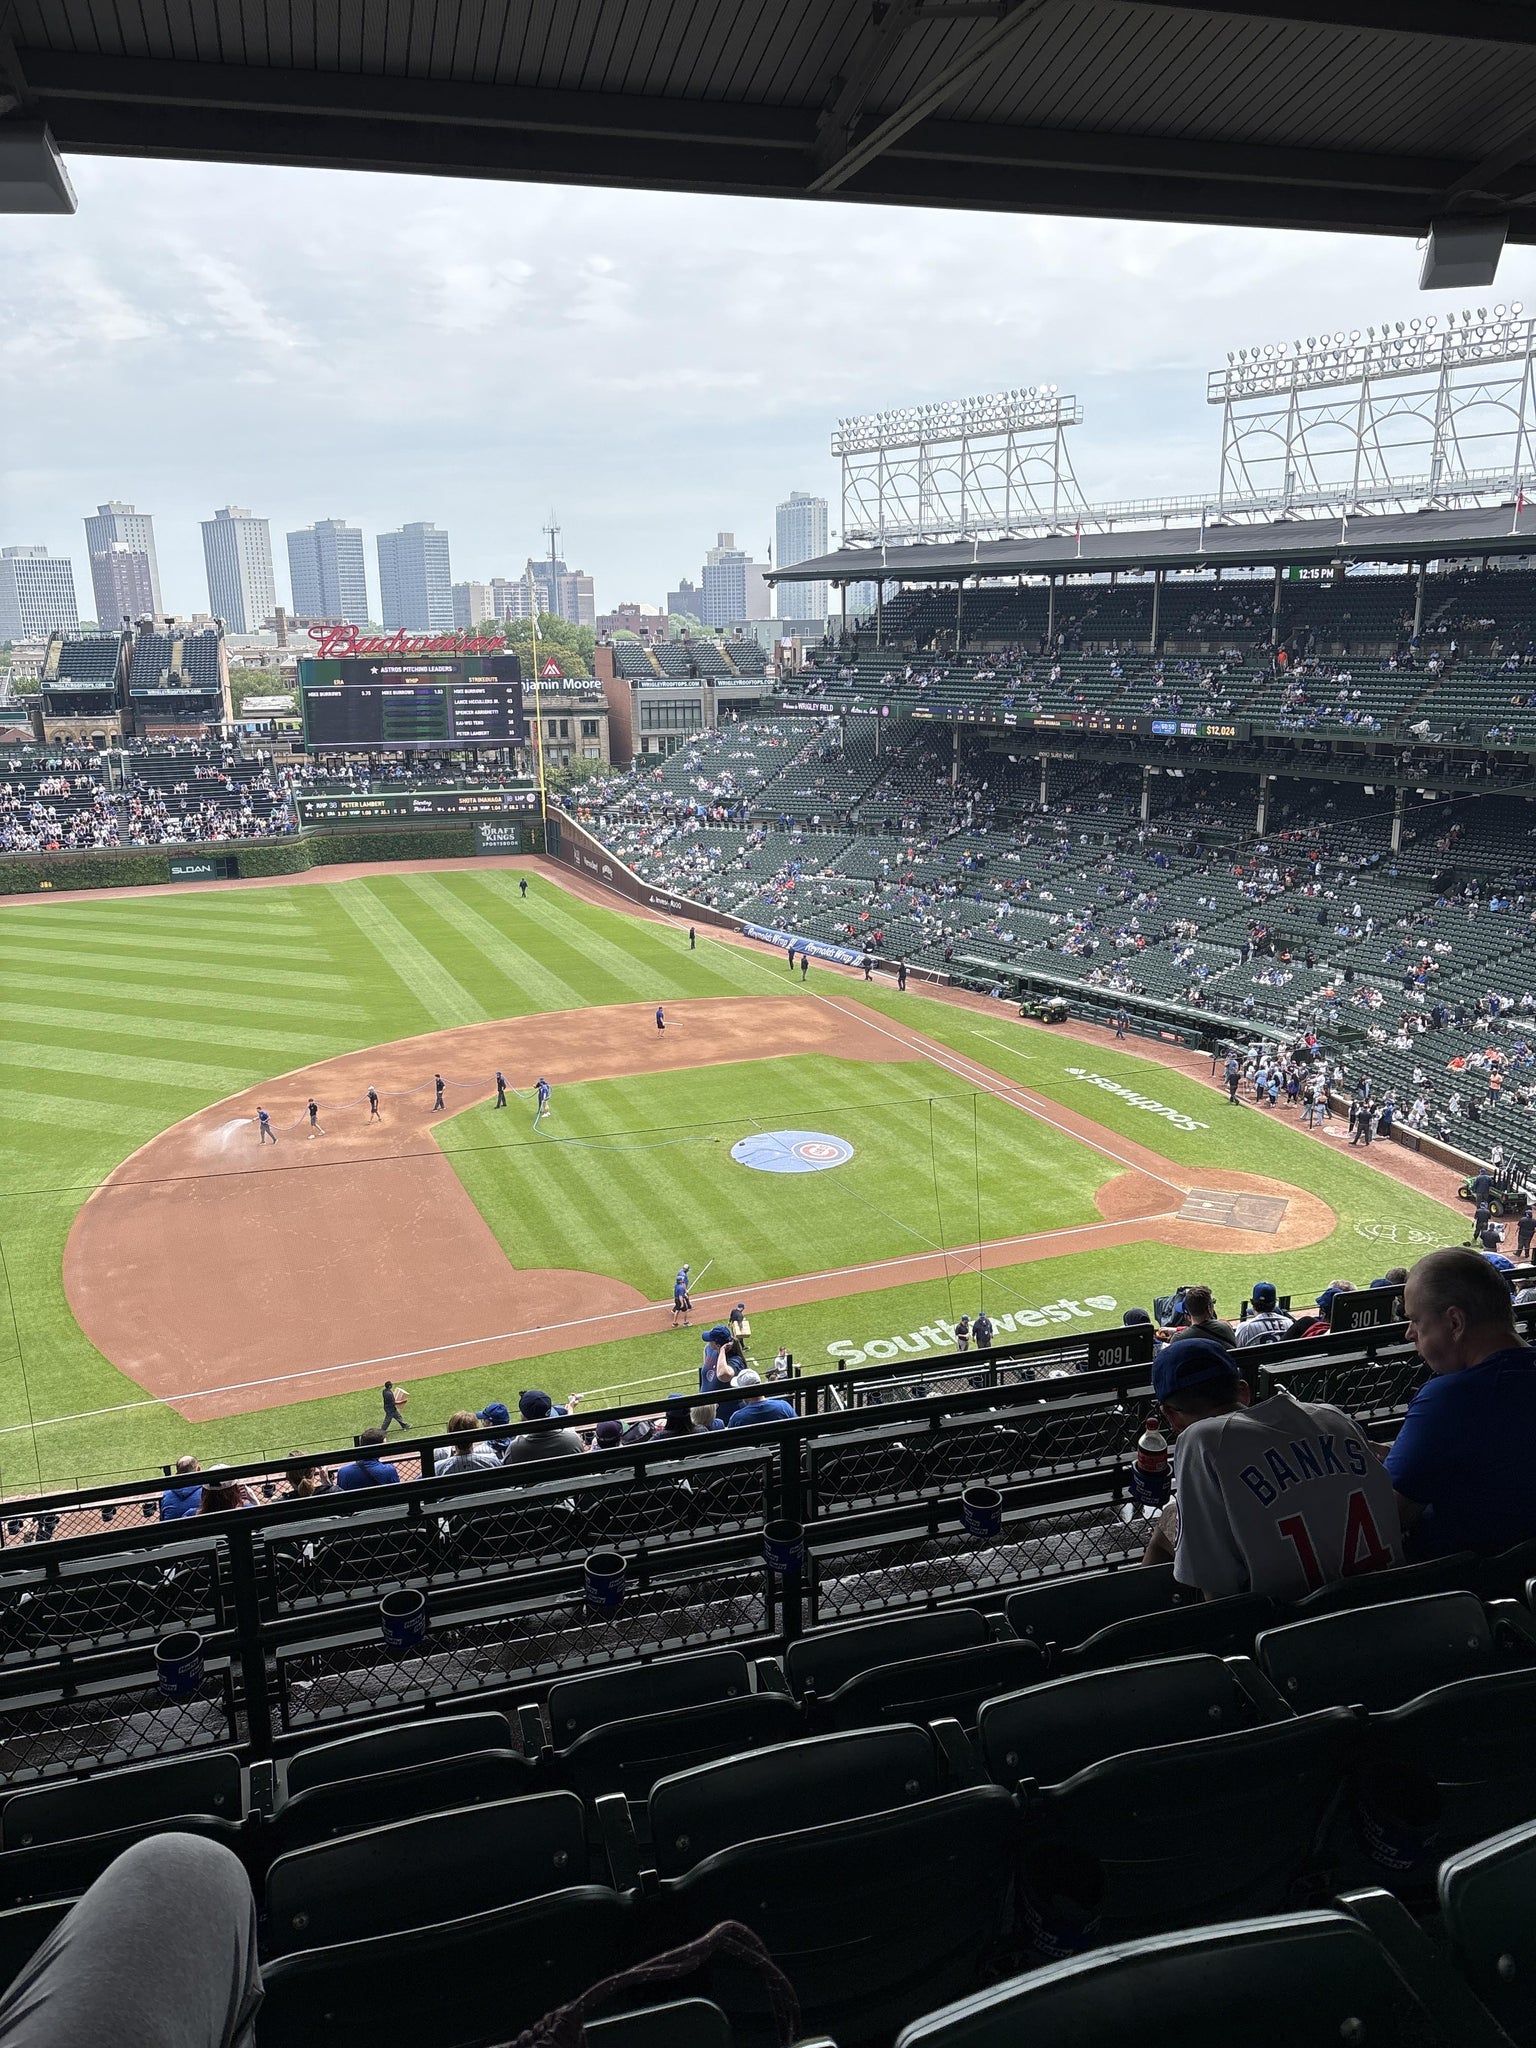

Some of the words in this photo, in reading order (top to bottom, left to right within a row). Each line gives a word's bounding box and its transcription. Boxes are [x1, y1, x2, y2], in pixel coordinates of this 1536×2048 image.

[1299, 568, 1320, 579] 12:15
[1321, 568, 1334, 579] PM
[308, 624, 507, 658] Budweiser
[563, 679, 602, 690] Moore
[798, 702, 820, 711] WRIGLEY
[820, 704, 834, 712] FIELD
[1180, 727, 1197, 736] TOTAL
[1206, 726, 1235, 736] $12,024
[359, 800, 385, 808] LAMBERT
[481, 826, 516, 837] DRAFT
[171, 865, 211, 875] SLOAN
[748, 927, 773, 943] Reynolds
[772, 934, 788, 947] Wrap
[805, 942, 835, 960] Reynolds
[835, 950, 854, 964] Wrap
[1076, 1073, 1211, 1131] Southwest
[1263, 1318, 1286, 1331] LEE
[1351, 1309, 1372, 1329] 310
[1373, 1308, 1381, 1325] L
[1098, 1346, 1123, 1367] 309
[1125, 1345, 1133, 1362] L
[1239, 1434, 1368, 1509] BANKS
[1276, 1487, 1396, 1592] 14
